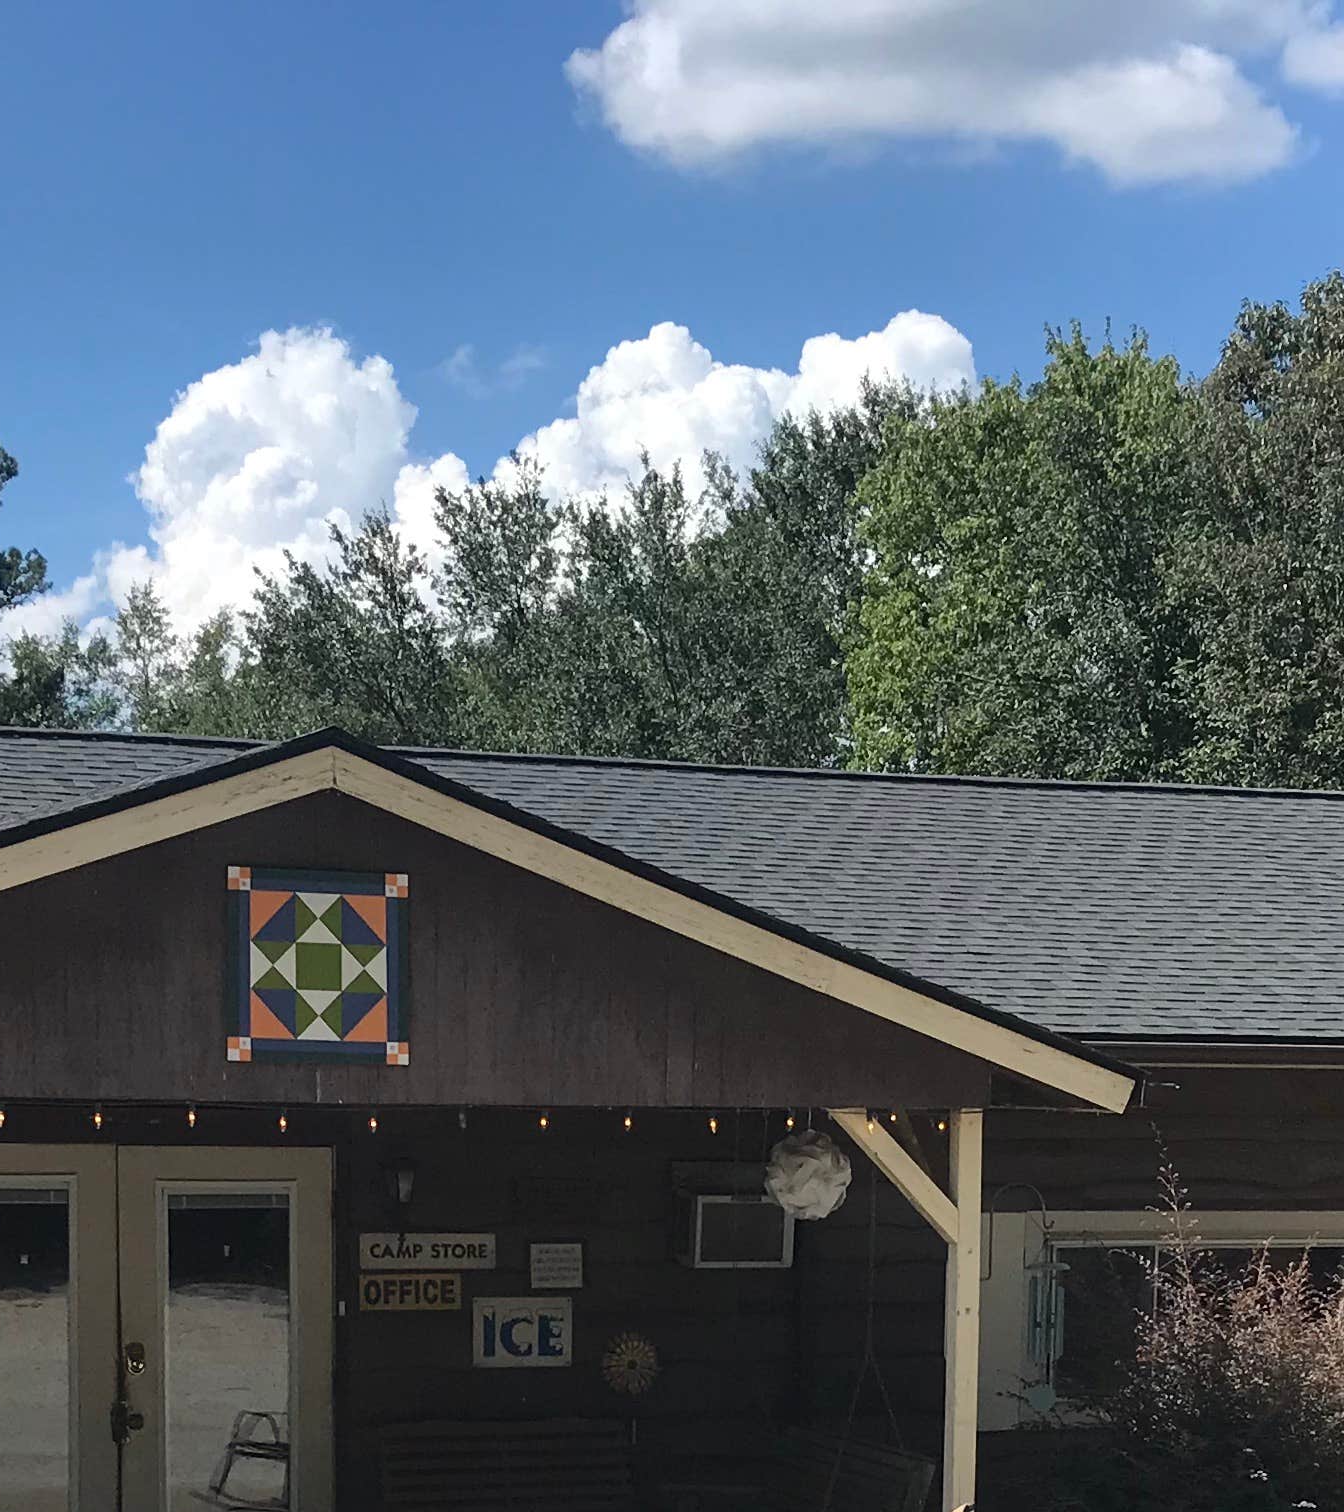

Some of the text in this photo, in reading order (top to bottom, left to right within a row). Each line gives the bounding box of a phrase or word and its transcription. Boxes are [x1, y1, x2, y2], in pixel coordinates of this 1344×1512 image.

[369, 1243, 488, 1259] CAMP STORE
[364, 1279, 456, 1305] OFFICE
[482, 1306, 564, 1357] ICE
